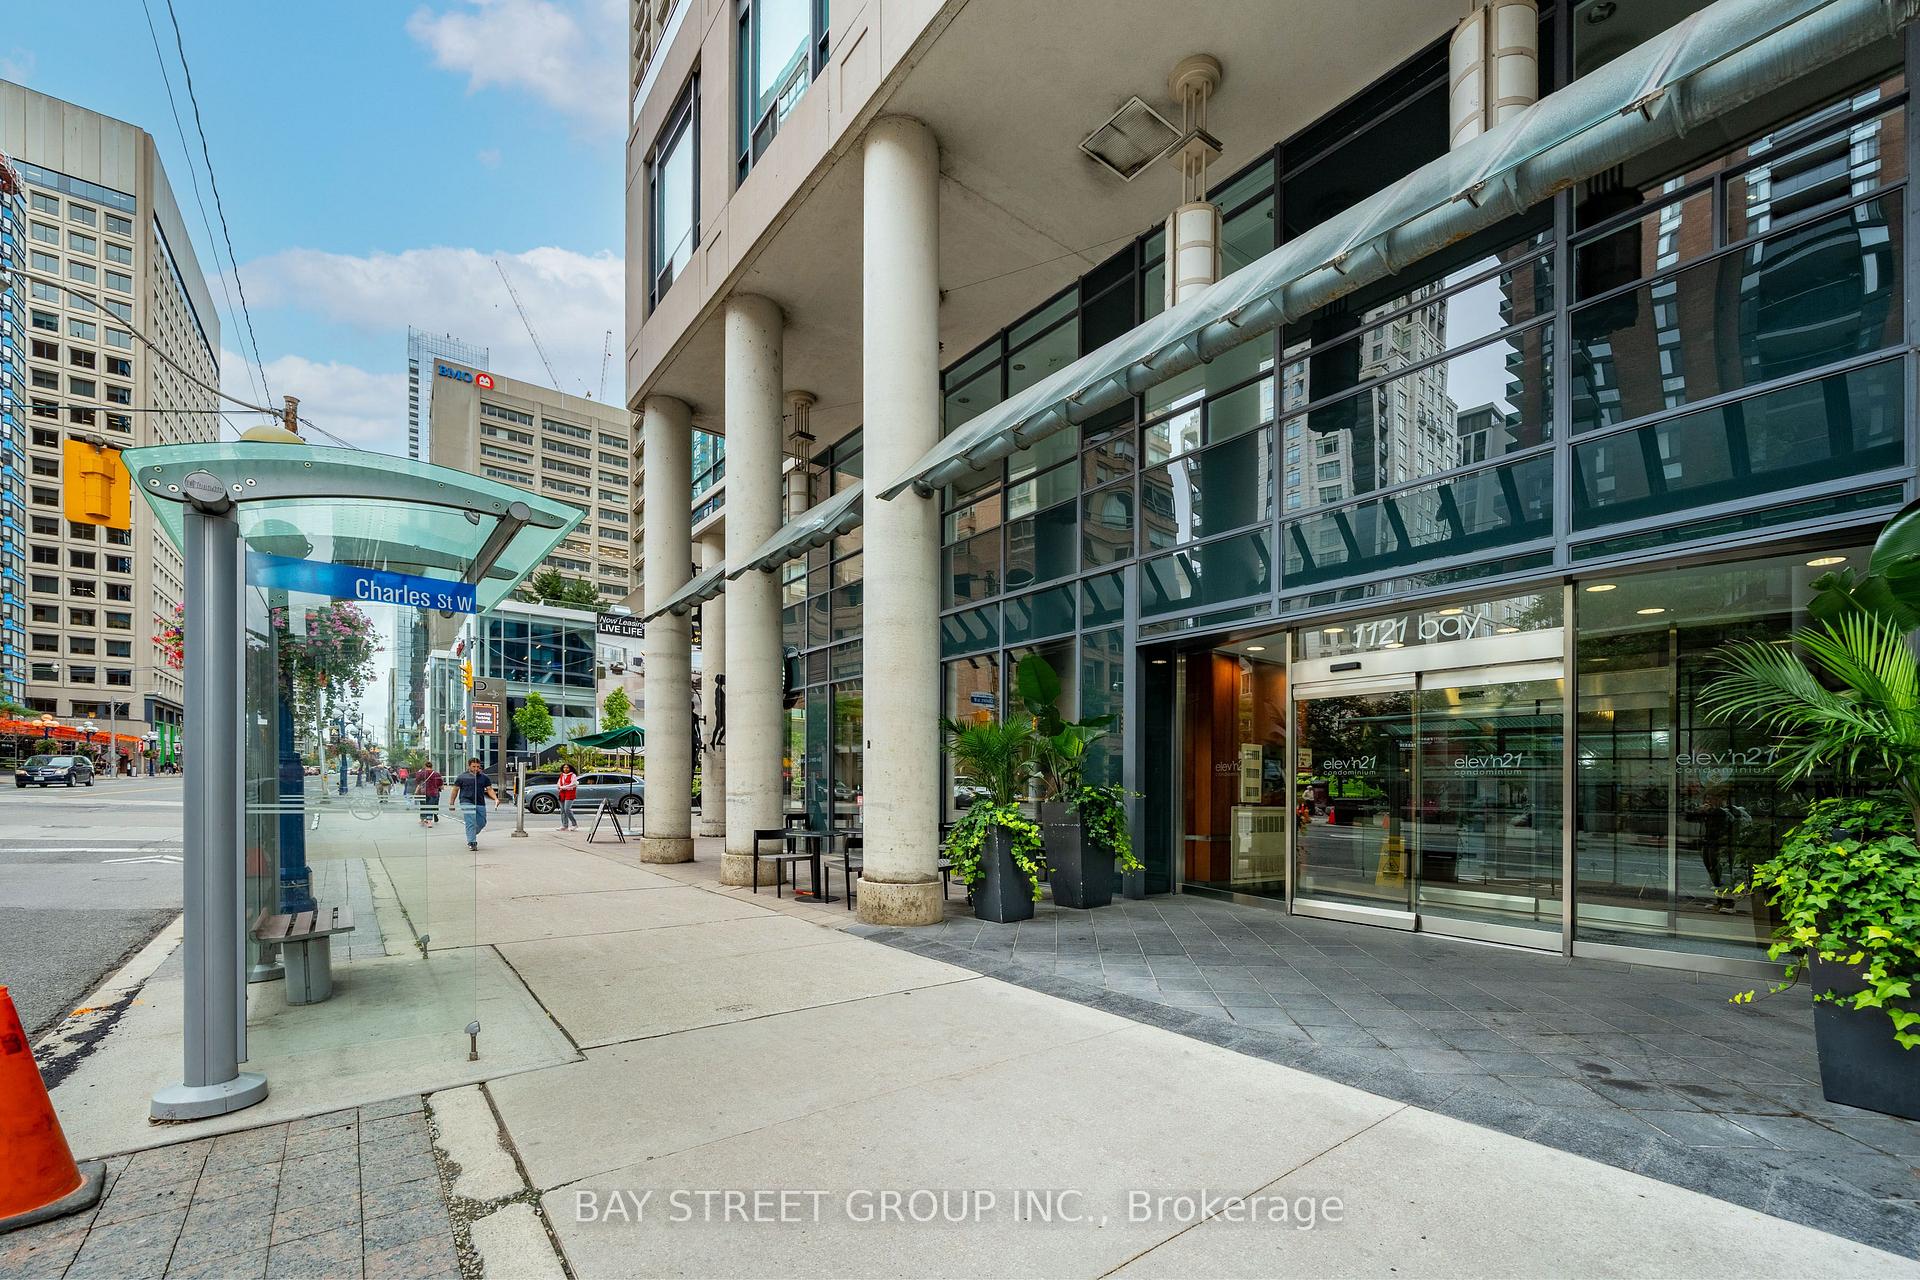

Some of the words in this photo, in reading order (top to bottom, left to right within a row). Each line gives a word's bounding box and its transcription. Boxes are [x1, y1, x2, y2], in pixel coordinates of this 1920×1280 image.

[438, 364, 473, 383] BMO
[355, 578, 431, 607] Charles
[437, 593, 453, 609] St
[457, 596, 472, 611] W
[600, 616, 618, 625] Now
[618, 618, 645, 629] Leasing
[600, 624, 621, 634] LIVE
[623, 628, 643, 636] LIFE
[1353, 616, 1408, 648] 1121
[1418, 612, 1482, 640] bay
[473, 680, 487, 697] P
[1323, 755, 1377, 770] elev'n21
[1454, 752, 1523, 768] elev'n21
